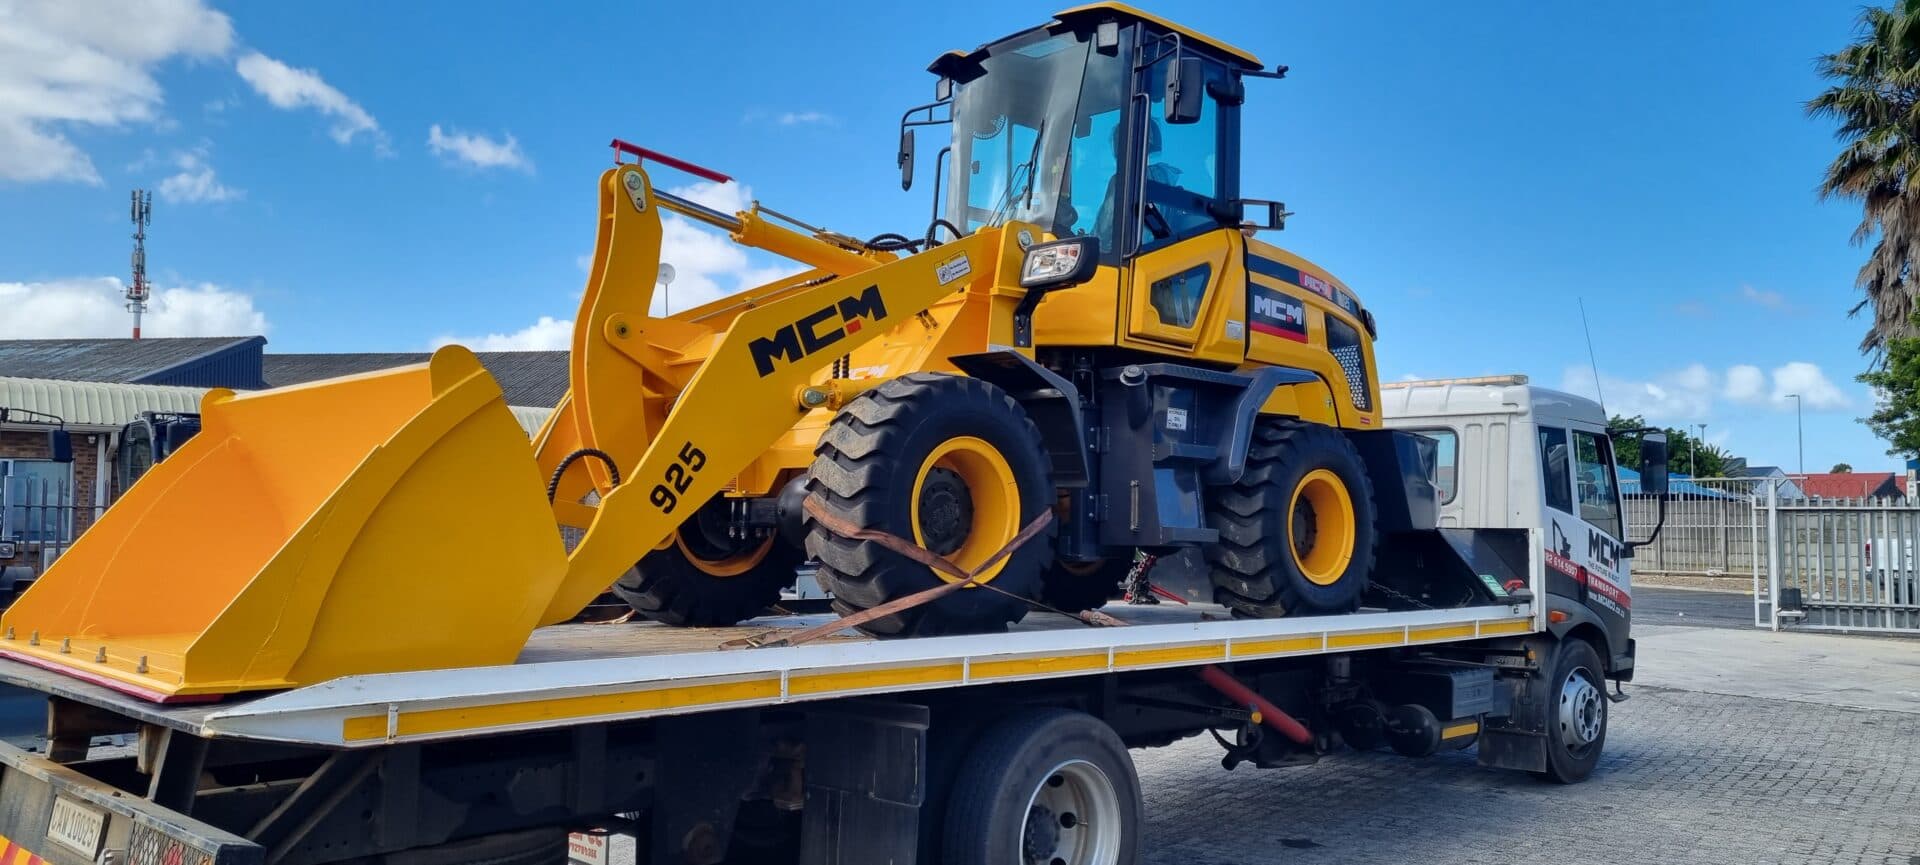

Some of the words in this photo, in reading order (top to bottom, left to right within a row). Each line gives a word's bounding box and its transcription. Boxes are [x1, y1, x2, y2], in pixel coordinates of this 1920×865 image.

[748, 284, 887, 378] MCM
[1254, 295, 1303, 325] MCM
[650, 441, 707, 514] 925
[1588, 528, 1619, 573] MCM
[1588, 574, 1618, 599] TRANSPORT
